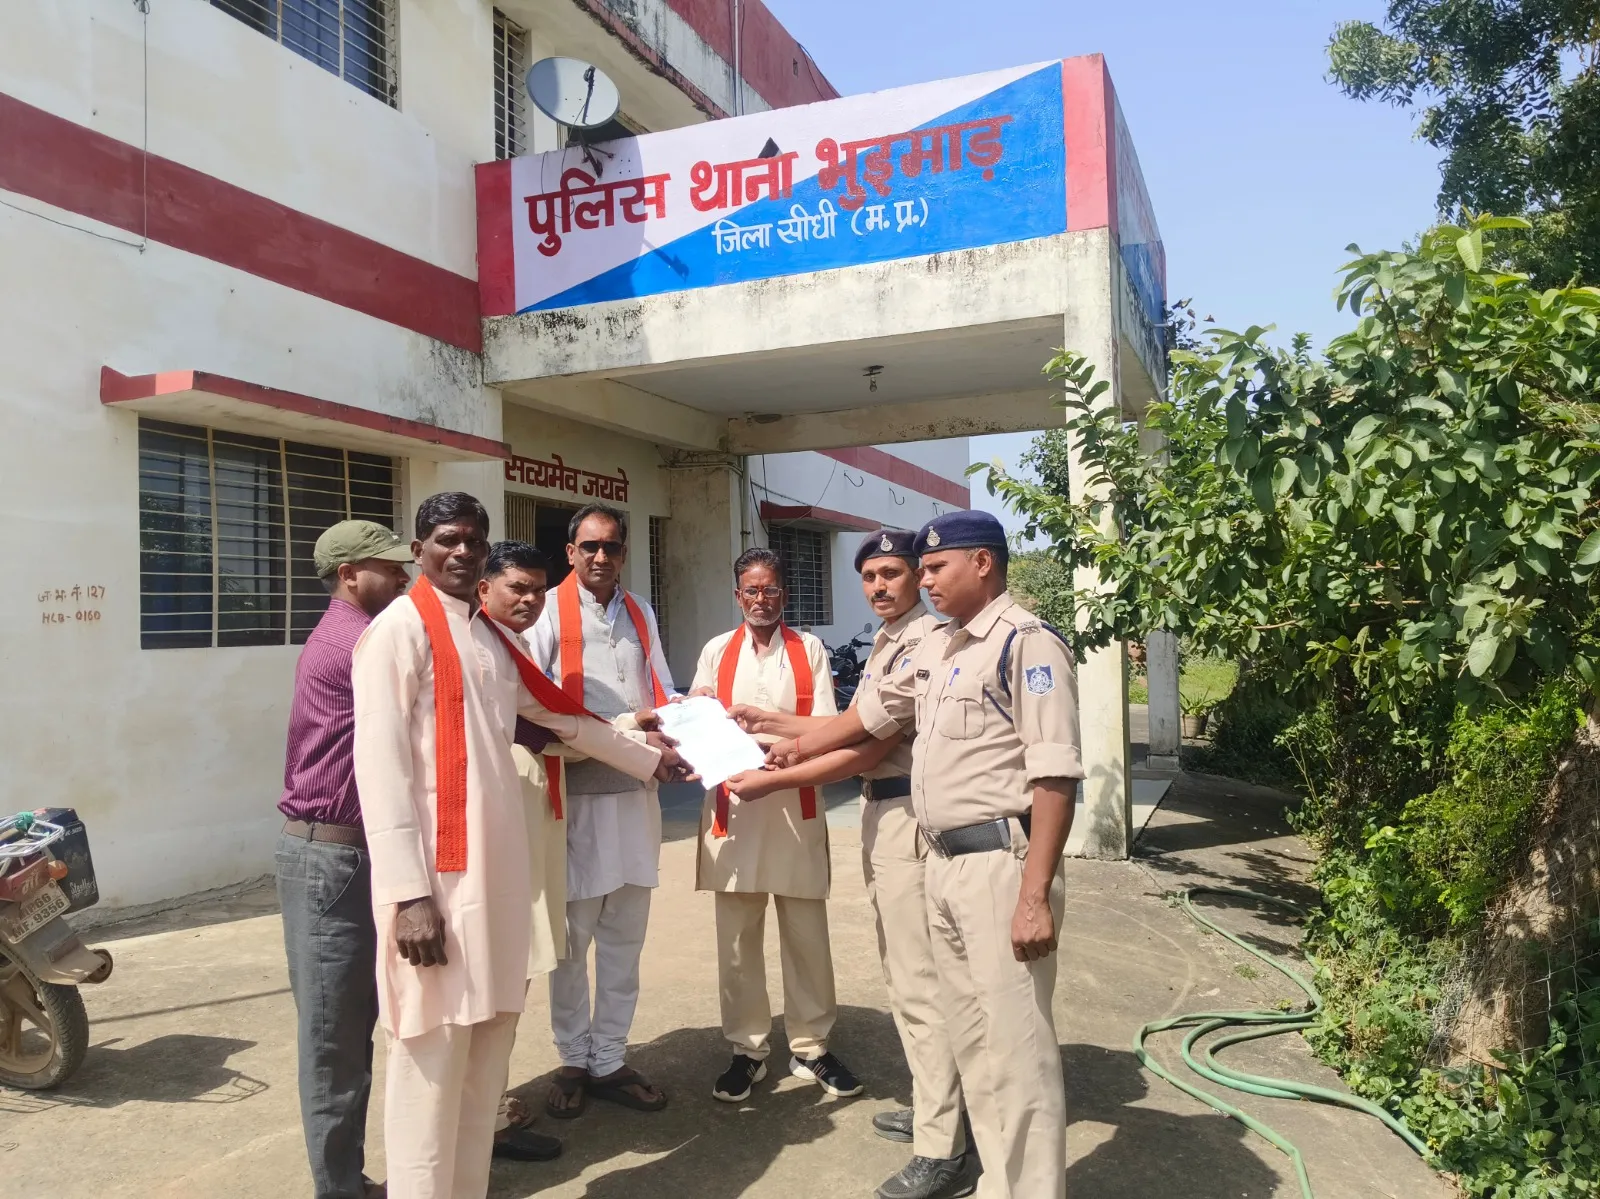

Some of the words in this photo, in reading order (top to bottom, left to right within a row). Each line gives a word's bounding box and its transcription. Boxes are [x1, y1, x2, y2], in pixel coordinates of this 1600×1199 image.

[524, 167, 671, 257] पुलिस
[690, 151, 799, 212] थाना
[815, 115, 1013, 211] भुइमाड़
[711, 219, 773, 255] जिला
[776, 198, 838, 245] सीधी
[504, 453, 581, 494] सत्यमेव
[581, 467, 629, 503] जयते
[87, 585, 105, 599] 127
